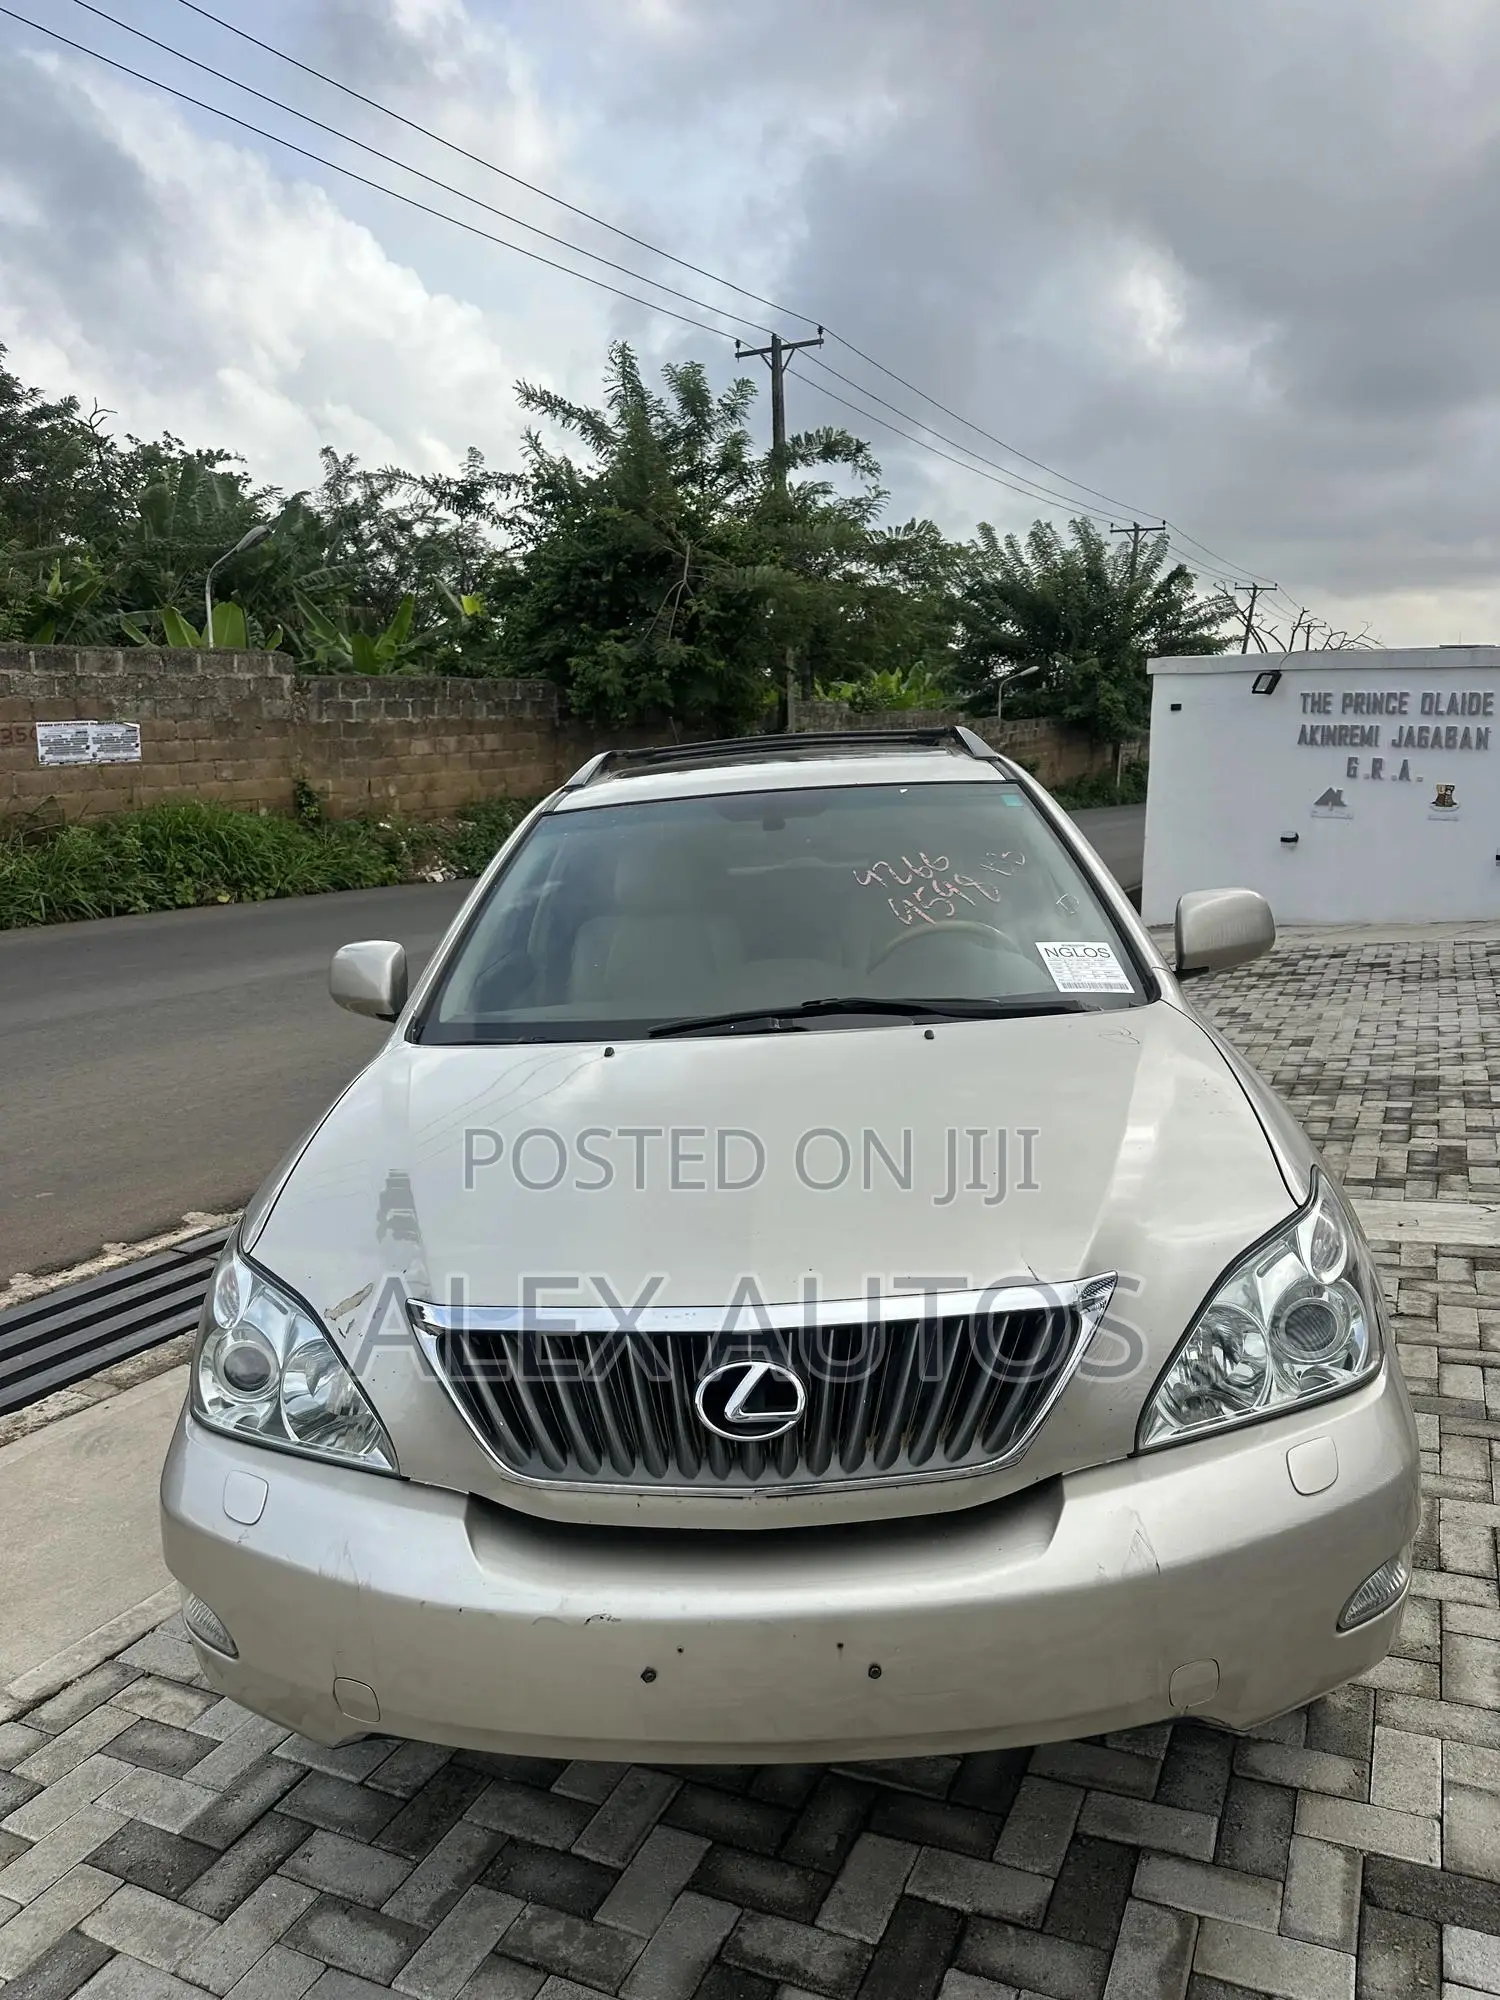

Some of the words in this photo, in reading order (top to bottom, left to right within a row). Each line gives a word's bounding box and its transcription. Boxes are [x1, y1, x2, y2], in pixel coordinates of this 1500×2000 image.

[1300, 691, 1333, 715] THE
[1341, 691, 1410, 716] PRINCE
[1420, 691, 1494, 717] OLAIDE
[1297, 723, 1380, 748] AKINREMI
[1391, 724, 1491, 751] JAGABAN
[1044, 947, 1111, 959] NGLOS
